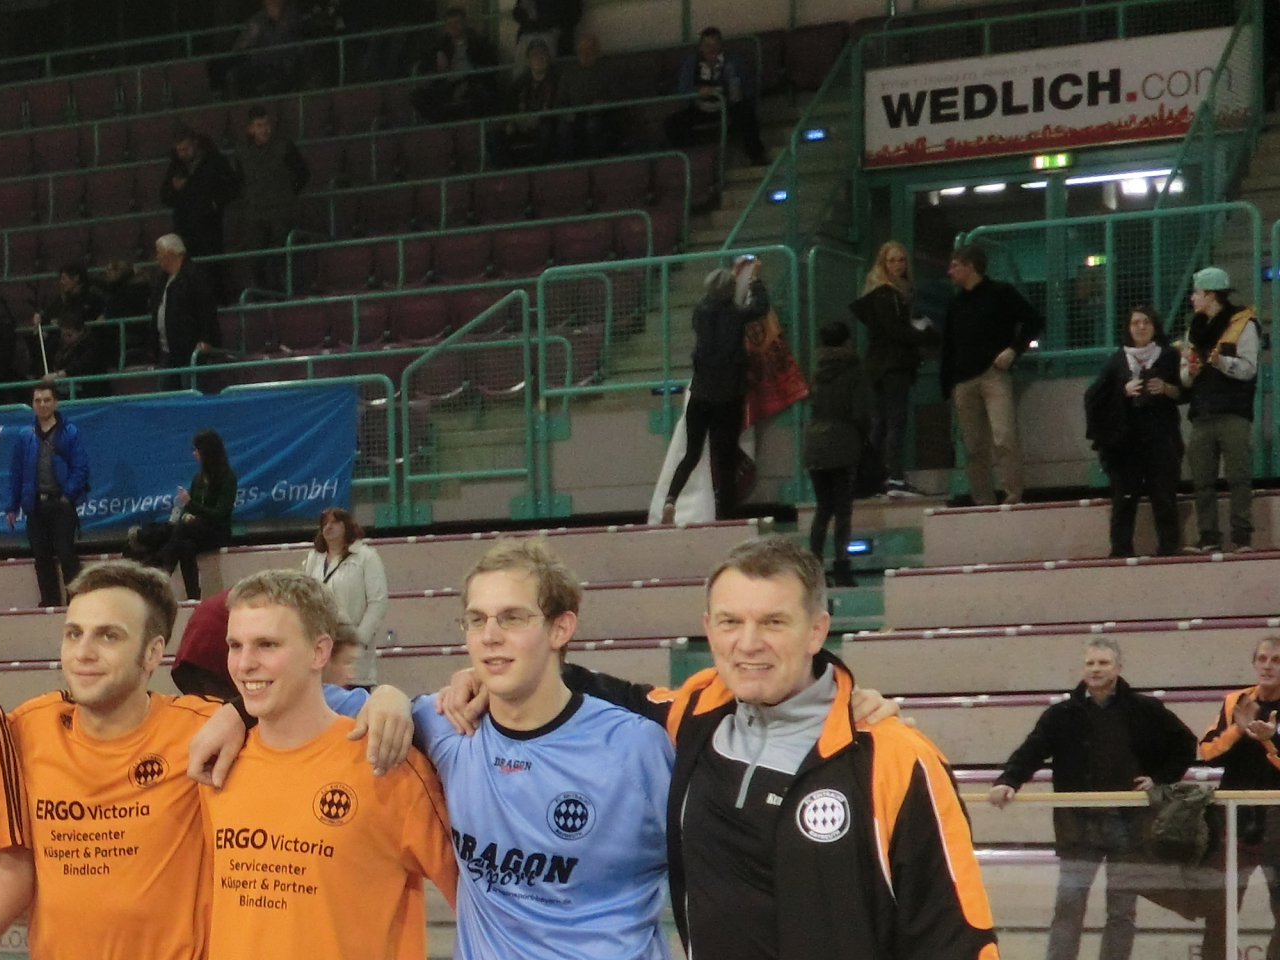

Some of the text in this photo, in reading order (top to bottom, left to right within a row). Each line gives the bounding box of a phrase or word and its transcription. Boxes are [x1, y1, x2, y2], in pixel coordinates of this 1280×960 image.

[881, 66, 1237, 129] WEDLICH.com
[271, 477, 339, 502] GmbH
[493, 756, 532, 771] DRAGON
[36, 799, 150, 821] ERGO Victoria
[50, 829, 125, 841] Servicecenter
[216, 828, 335, 858] ERGO Victoria
[43, 845, 140, 861] Küspert & Partner
[63, 862, 110, 876] Bindlach
[229, 858, 307, 876] Servicecenter
[466, 857, 537, 893] Sport
[221, 876, 318, 895] Küspert & Partner
[239, 894, 288, 910] Bindlach
